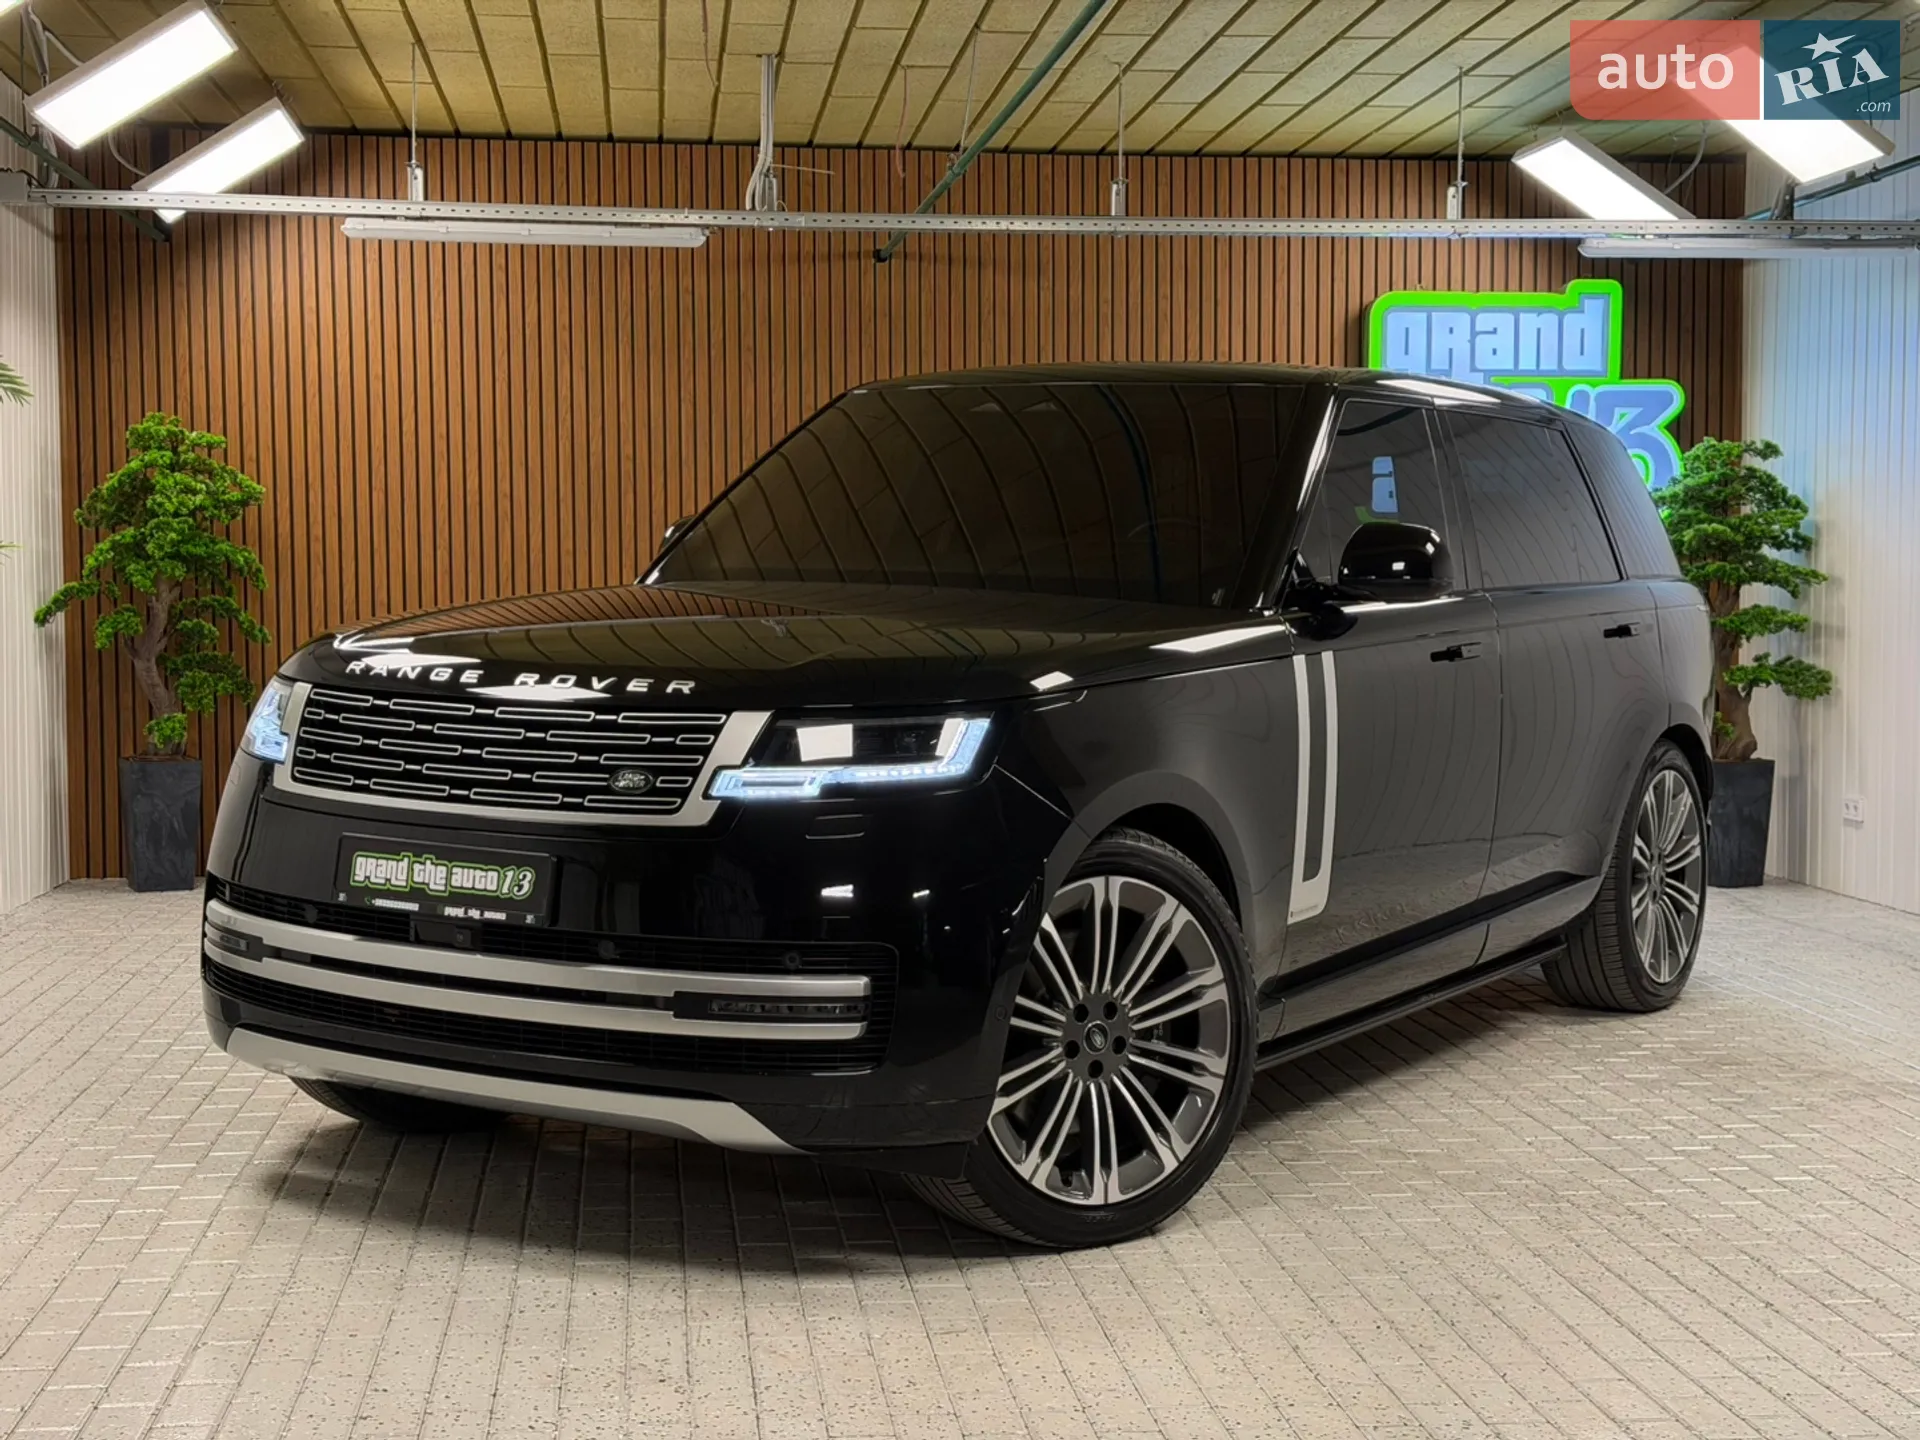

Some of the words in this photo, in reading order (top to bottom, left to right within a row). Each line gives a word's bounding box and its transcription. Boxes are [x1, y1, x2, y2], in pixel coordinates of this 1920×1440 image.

[345, 660, 484, 683] RANGE
[513, 672, 696, 695] ROVER
[412, 859, 447, 891] the
[451, 867, 499, 891] auto
[501, 869, 533, 896] 13
